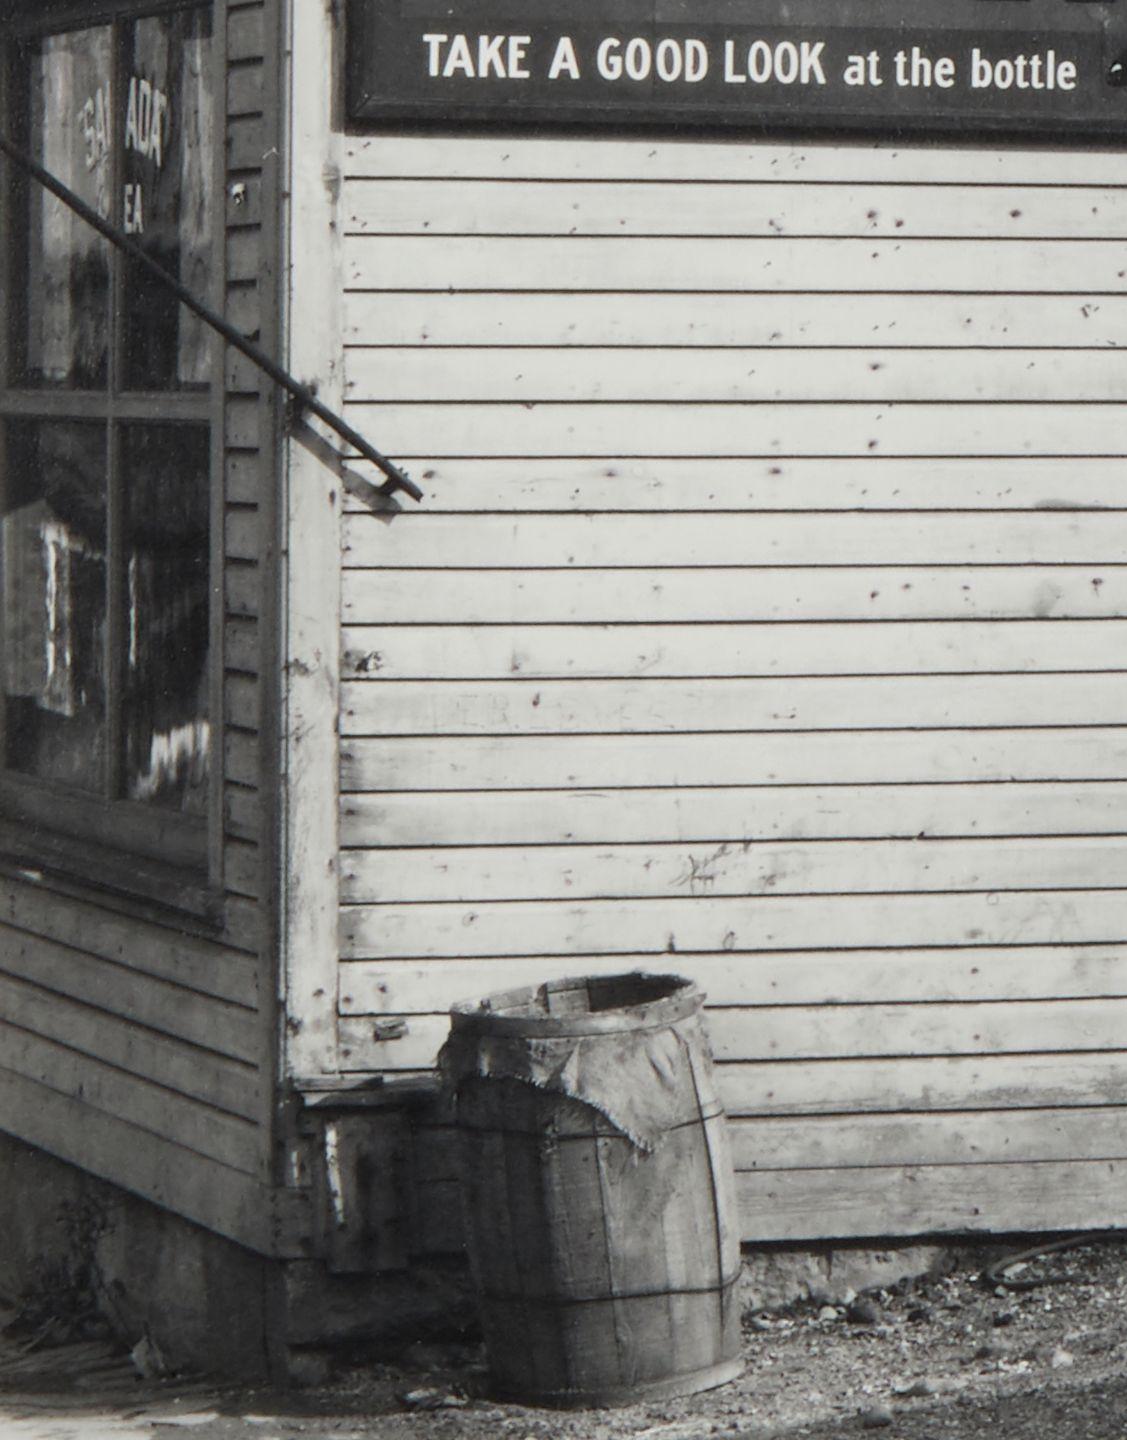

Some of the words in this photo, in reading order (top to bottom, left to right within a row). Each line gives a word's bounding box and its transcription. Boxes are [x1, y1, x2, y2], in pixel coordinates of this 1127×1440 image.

[422, 33, 532, 78] TAKE
[548, 36, 580, 79] A
[597, 37, 709, 82] GOOD
[724, 39, 827, 85] LOOK
[843, 50, 883, 86] at
[893, 46, 956, 88] the
[971, 47, 1077, 91] bottle
